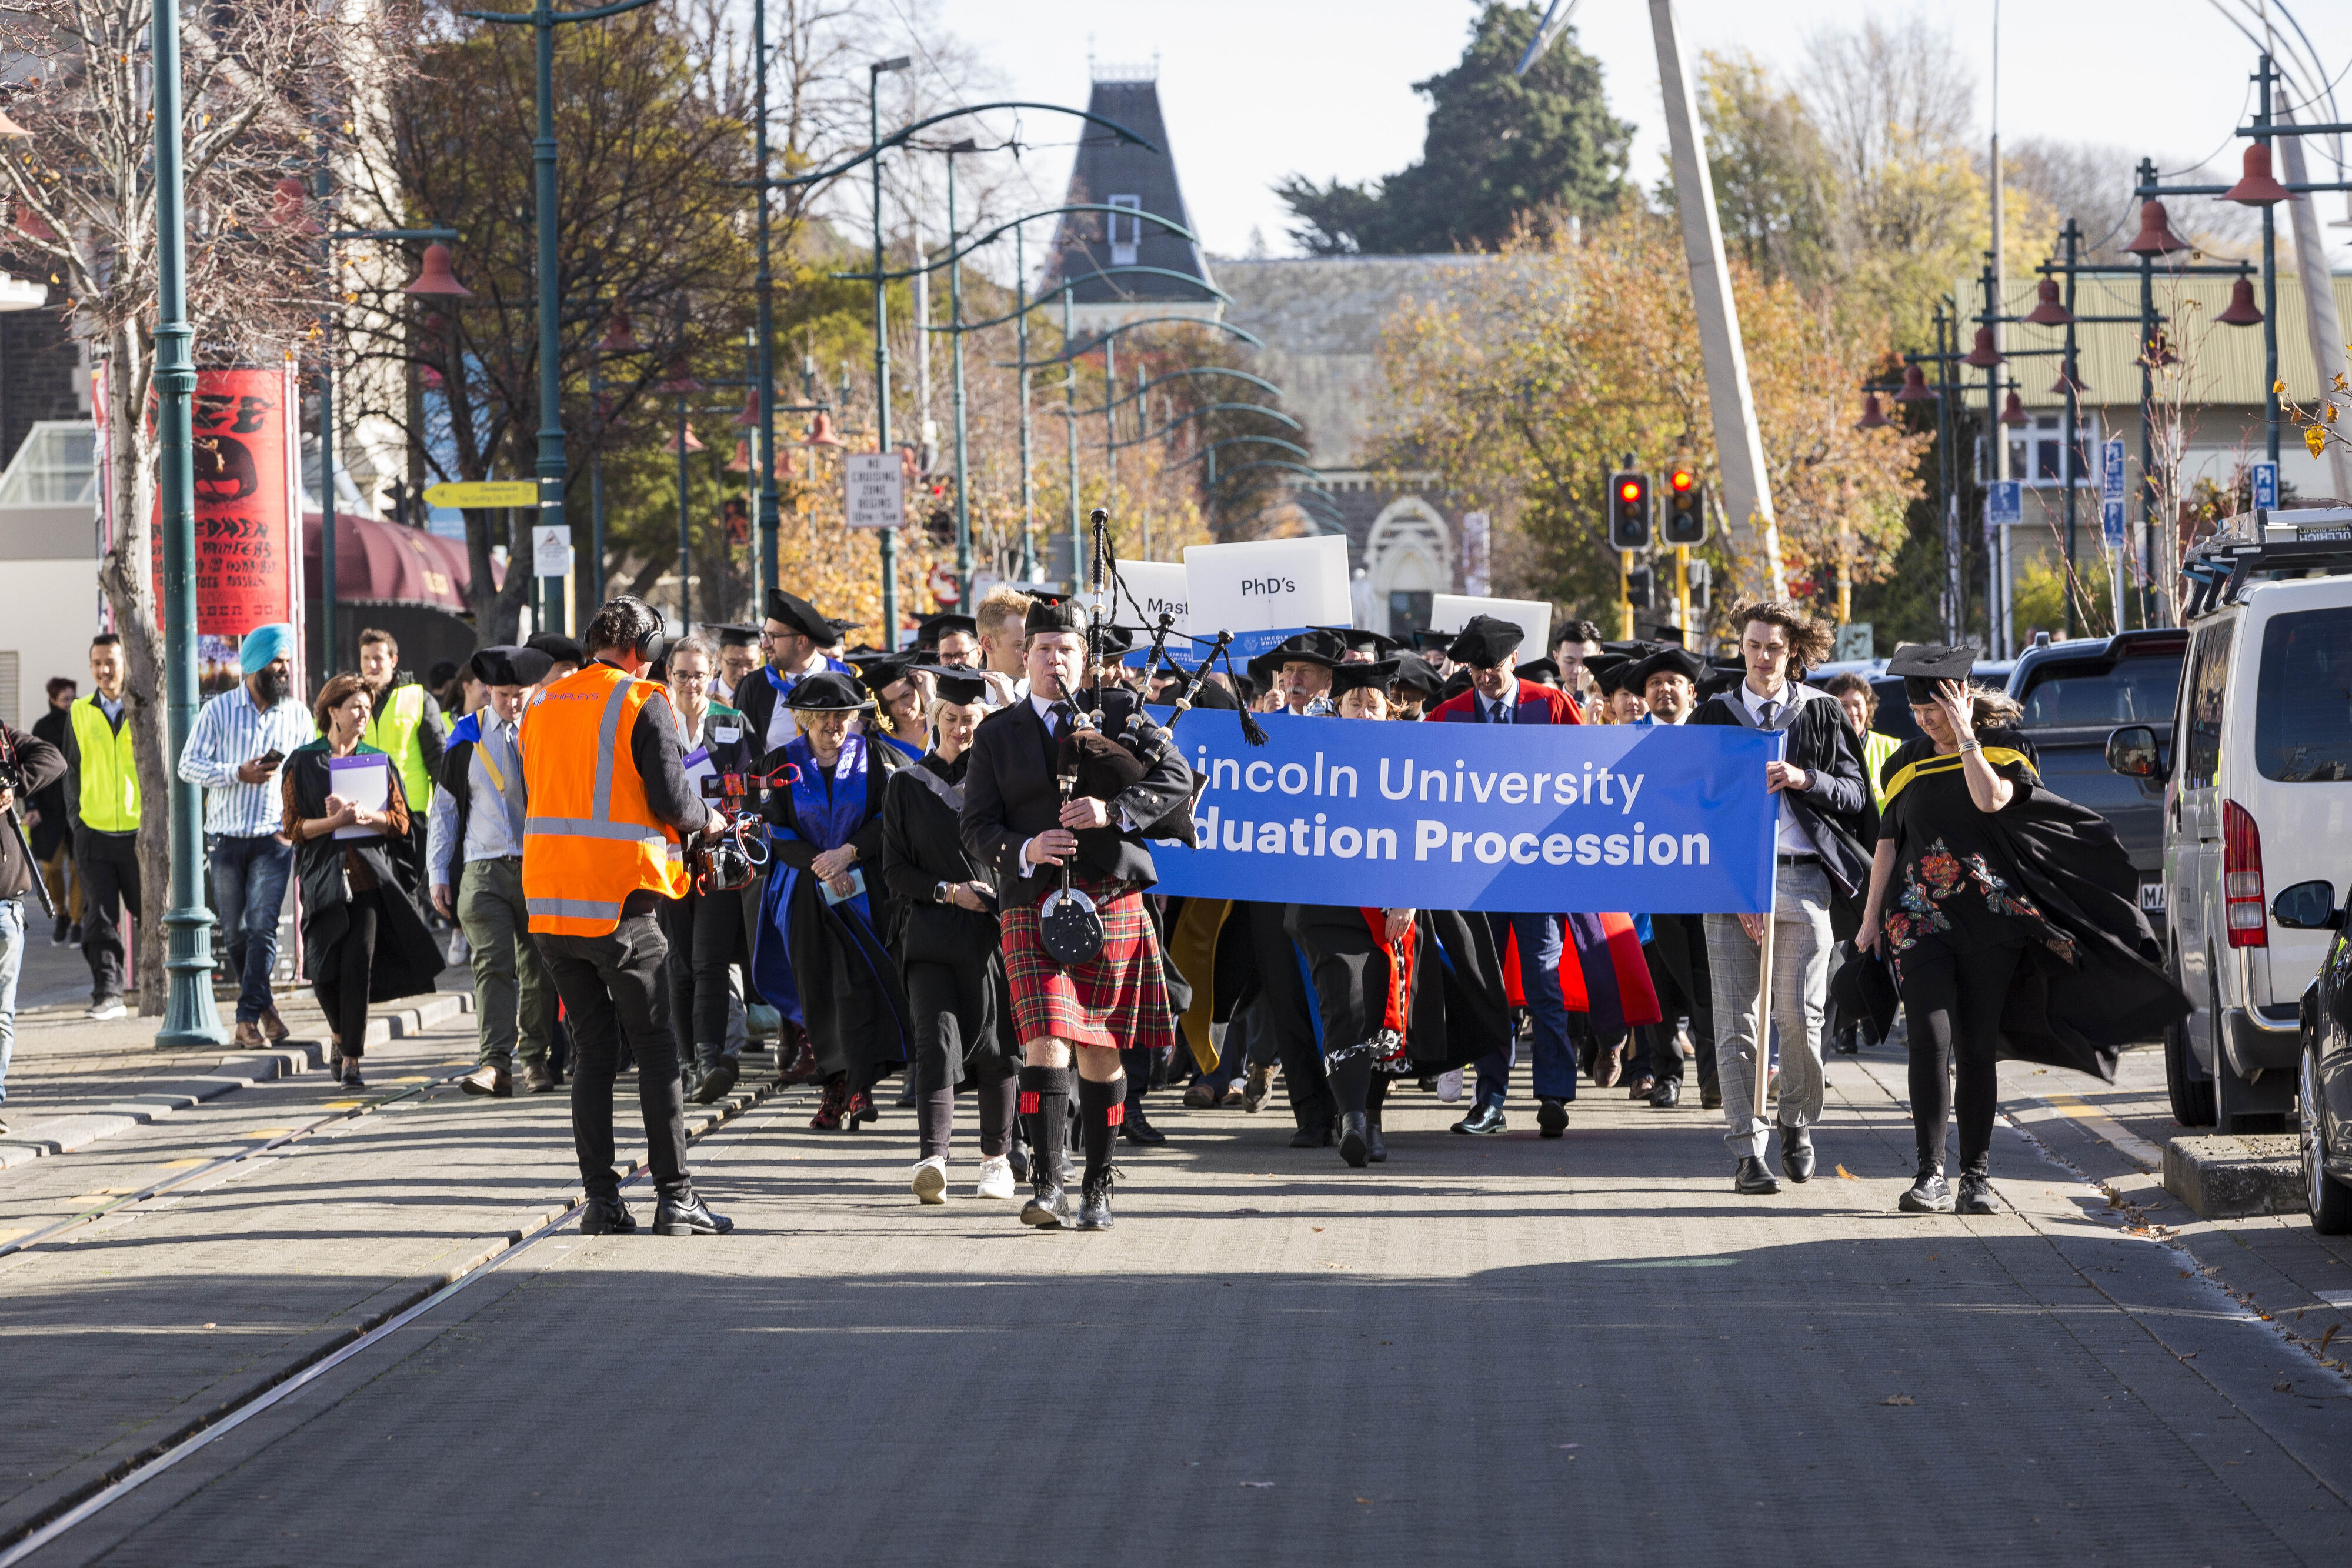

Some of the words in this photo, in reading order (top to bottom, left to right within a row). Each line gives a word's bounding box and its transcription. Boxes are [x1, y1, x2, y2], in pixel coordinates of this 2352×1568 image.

[867, 458, 881, 469] NO
[851, 471, 897, 482] CRUISING
[862, 485, 886, 495] ZONE
[858, 498, 892, 509] BEGINS
[1241, 577, 1295, 596] PhD's
[1147, 598, 1189, 615] Mast
[546, 692, 599, 701] SHIPLEYS
[1196, 745, 1359, 799] incoln
[1379, 758, 1644, 815] University
[1154, 806, 1397, 860] duation
[1414, 820, 1710, 865] Procession
